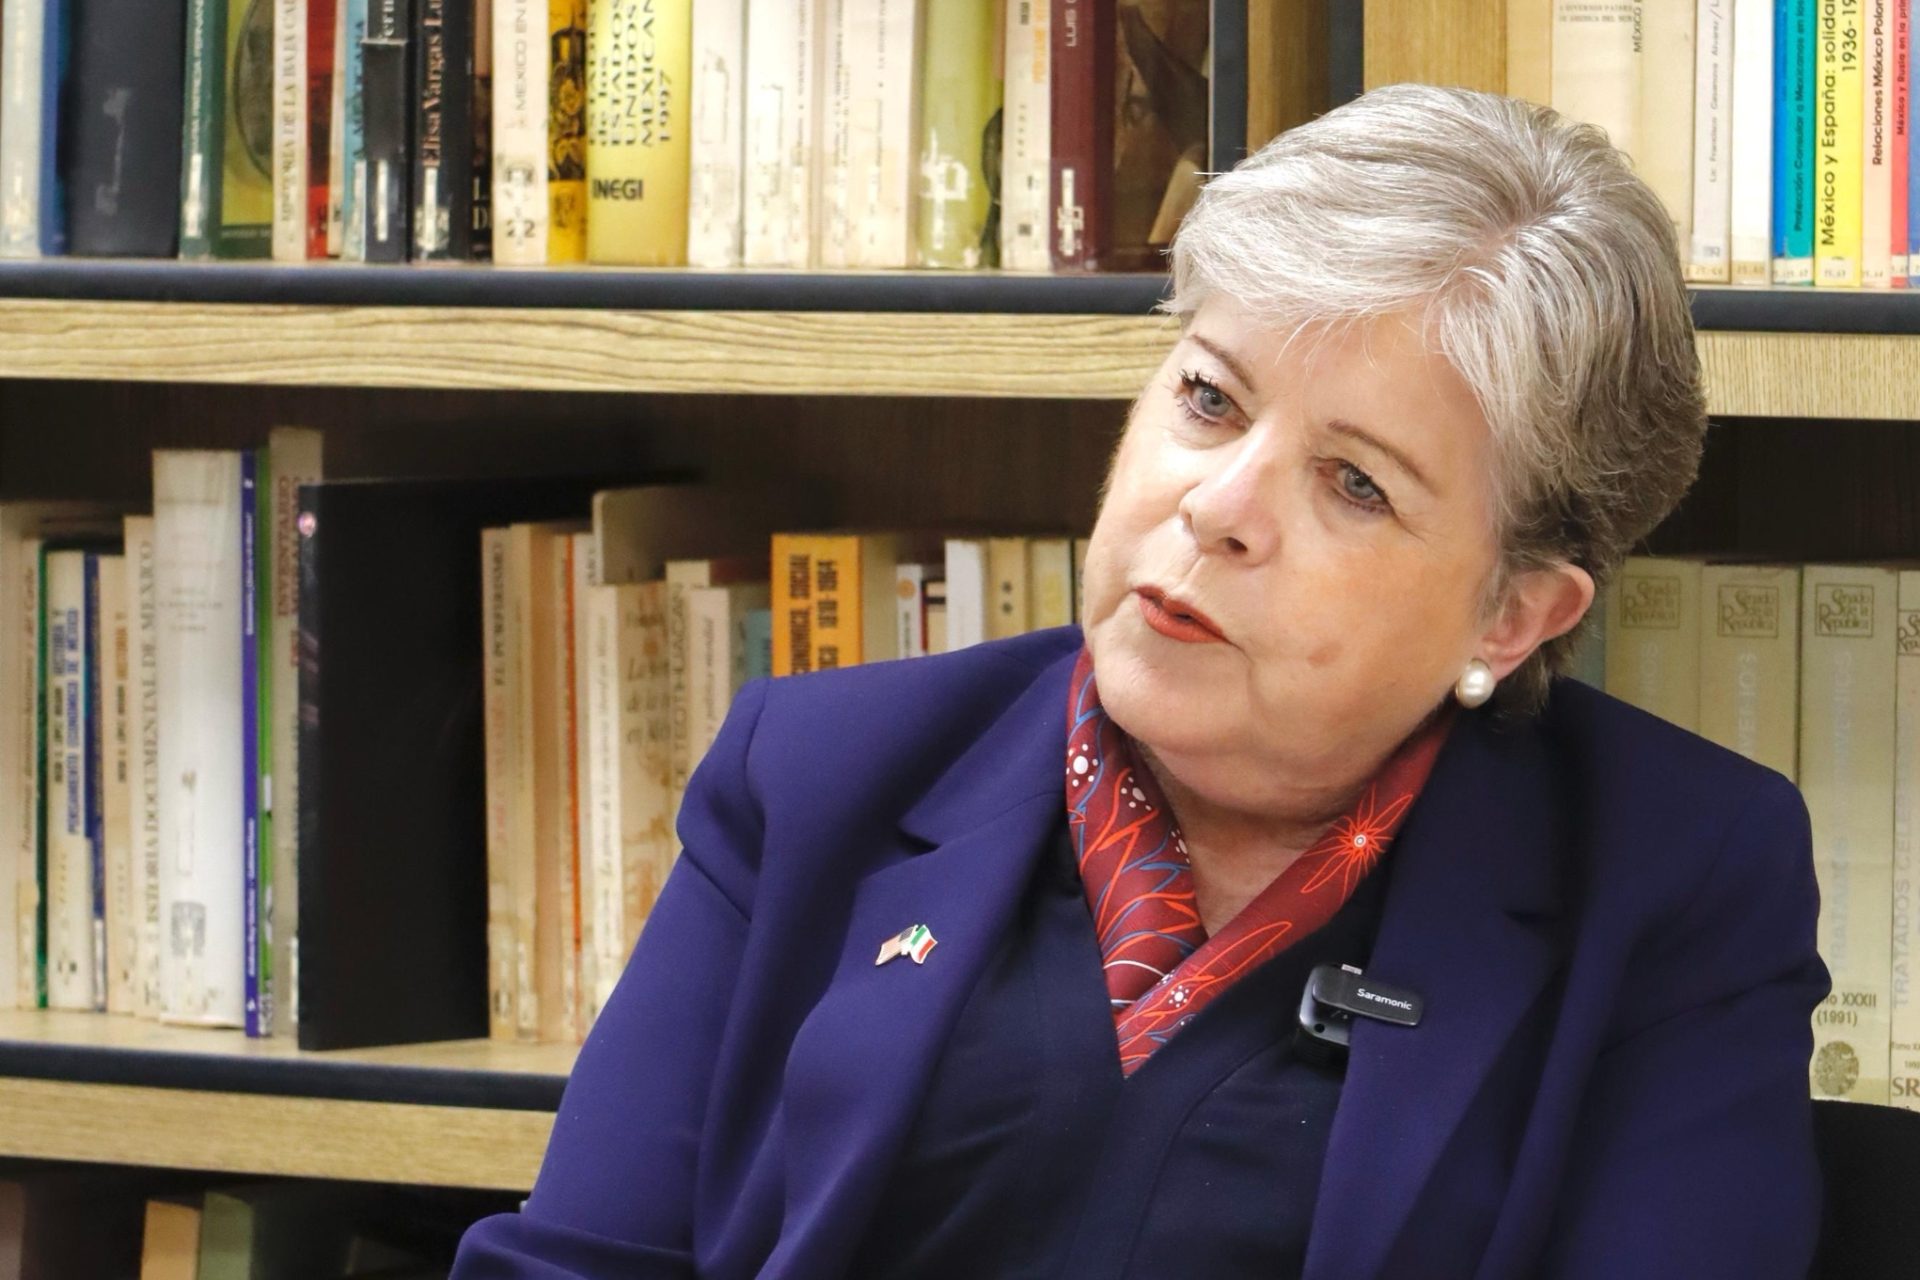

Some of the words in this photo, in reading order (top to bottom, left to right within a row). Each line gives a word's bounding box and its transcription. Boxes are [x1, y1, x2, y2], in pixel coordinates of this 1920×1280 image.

[1066, 9, 1079, 47] LUIS
[1632, 7, 1643, 53] MÉXICO
[423, 35, 444, 110] Vargas
[625, 3, 637, 147] UNIDOS
[1795, 37, 1806, 103] Mexicanos
[1868, 38, 1884, 88] México
[1896, 53, 1907, 83] Rusia
[1820, 69, 1839, 149] España:
[1870, 90, 1882, 166] Relaciones
[1895, 96, 1907, 136] México
[421, 111, 442, 169] Elisa
[1794, 115, 1805, 170] Consular
[1824, 153, 1839, 166] y
[592, 178, 643, 201] INEGI
[1792, 171, 1804, 233] Protección
[1819, 170, 1837, 247] México
[277, 476, 290, 617] INVENTARIO
[142, 641, 156, 667] DE
[143, 672, 159, 832] DOCUMENTAL
[145, 838, 161, 924] ISTORIA
[1893, 878, 1911, 1010] TRATADOS
[1357, 988, 1412, 1010] Saramonic
[1816, 1010, 1858, 1027] (1991)
[1842, 992, 1877, 1008] XXXII
